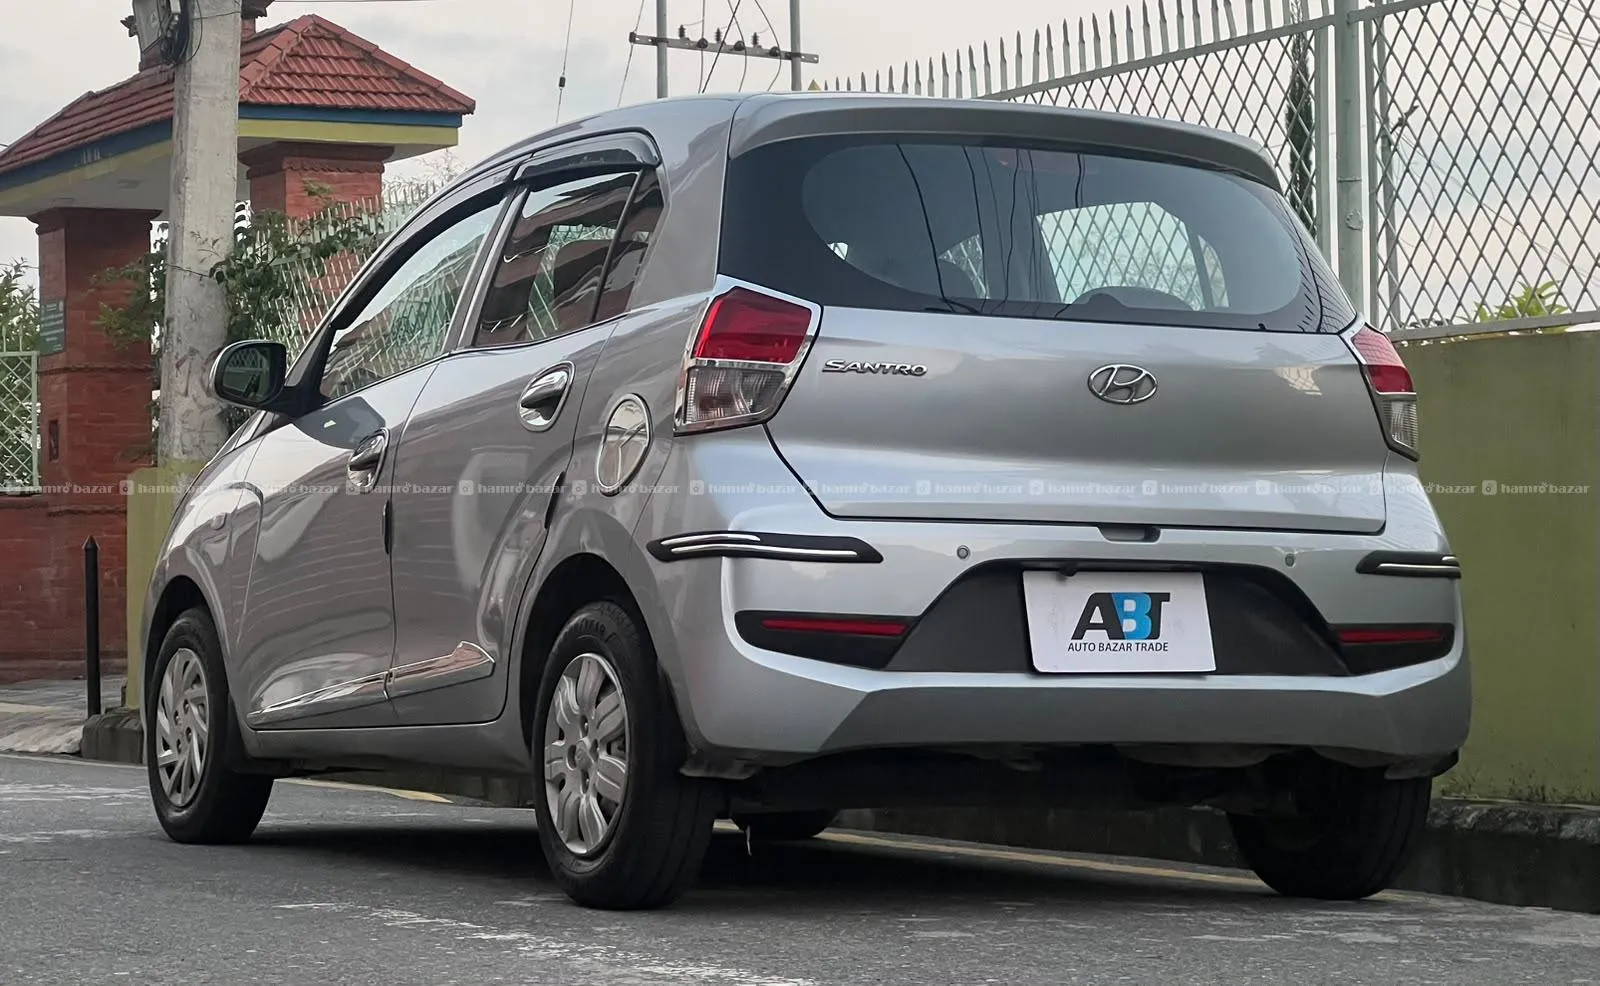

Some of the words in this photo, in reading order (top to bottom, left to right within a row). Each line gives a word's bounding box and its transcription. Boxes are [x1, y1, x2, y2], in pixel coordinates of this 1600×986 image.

[822, 359, 928, 377] SANTRO
[1071, 592, 1171, 640] ABT
[1067, 642, 1096, 652] AUTO
[1098, 642, 1133, 652] BAZAR
[1135, 642, 1169, 652] TRADE
